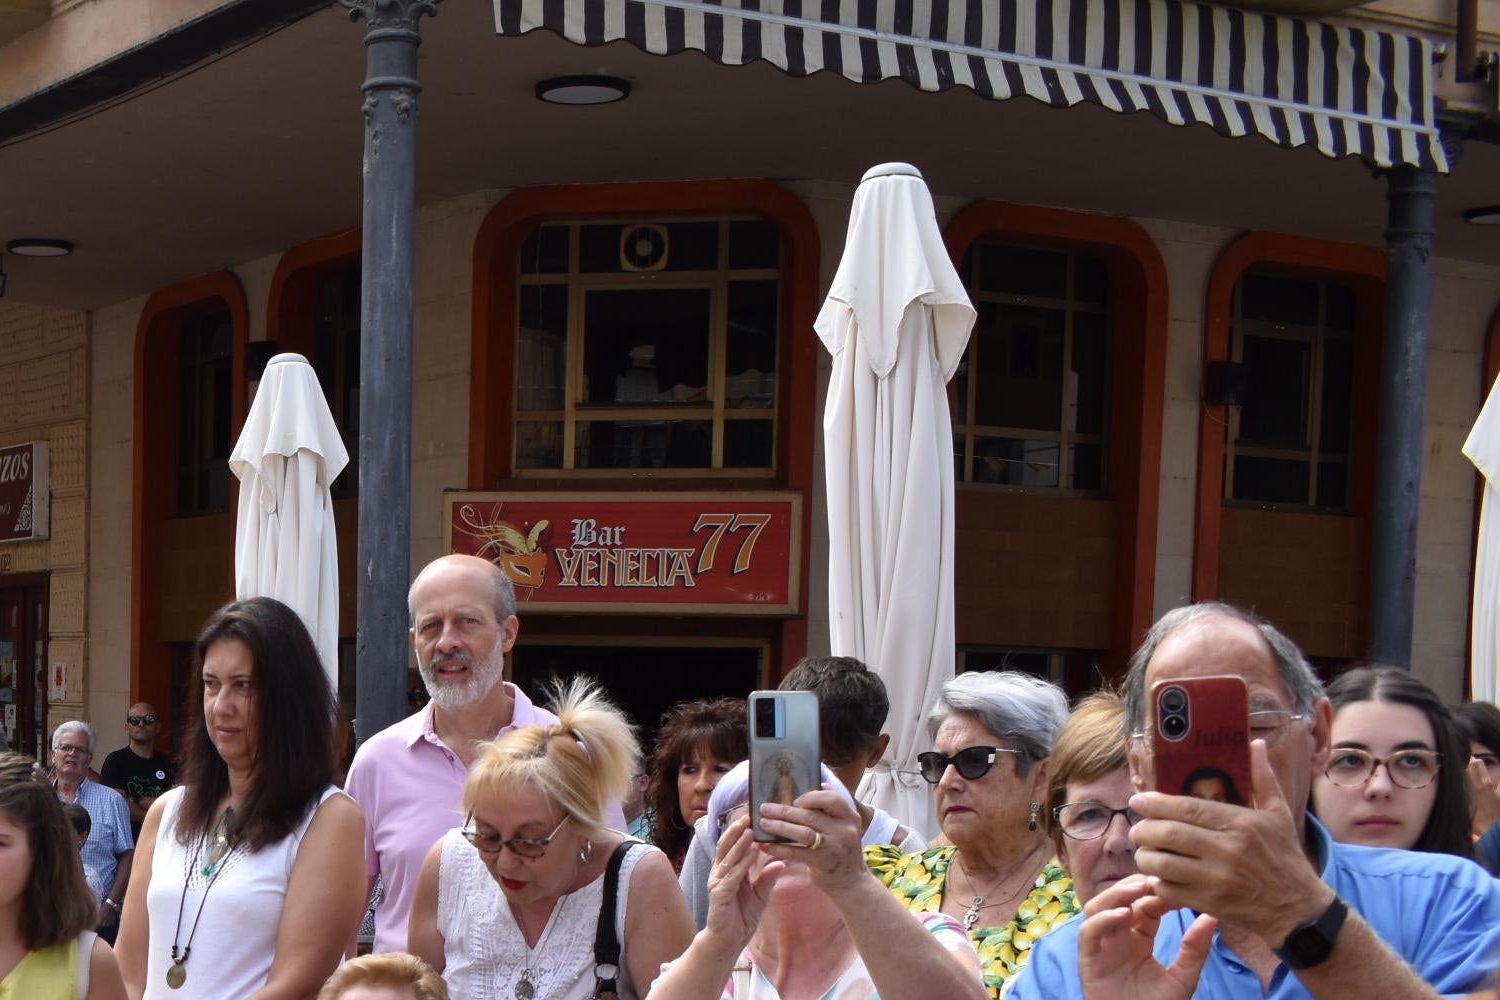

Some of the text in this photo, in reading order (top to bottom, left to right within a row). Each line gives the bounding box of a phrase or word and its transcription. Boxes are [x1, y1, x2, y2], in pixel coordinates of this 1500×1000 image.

[555, 513, 772, 587] VENECIA 77
[569, 518, 627, 548] Bar
